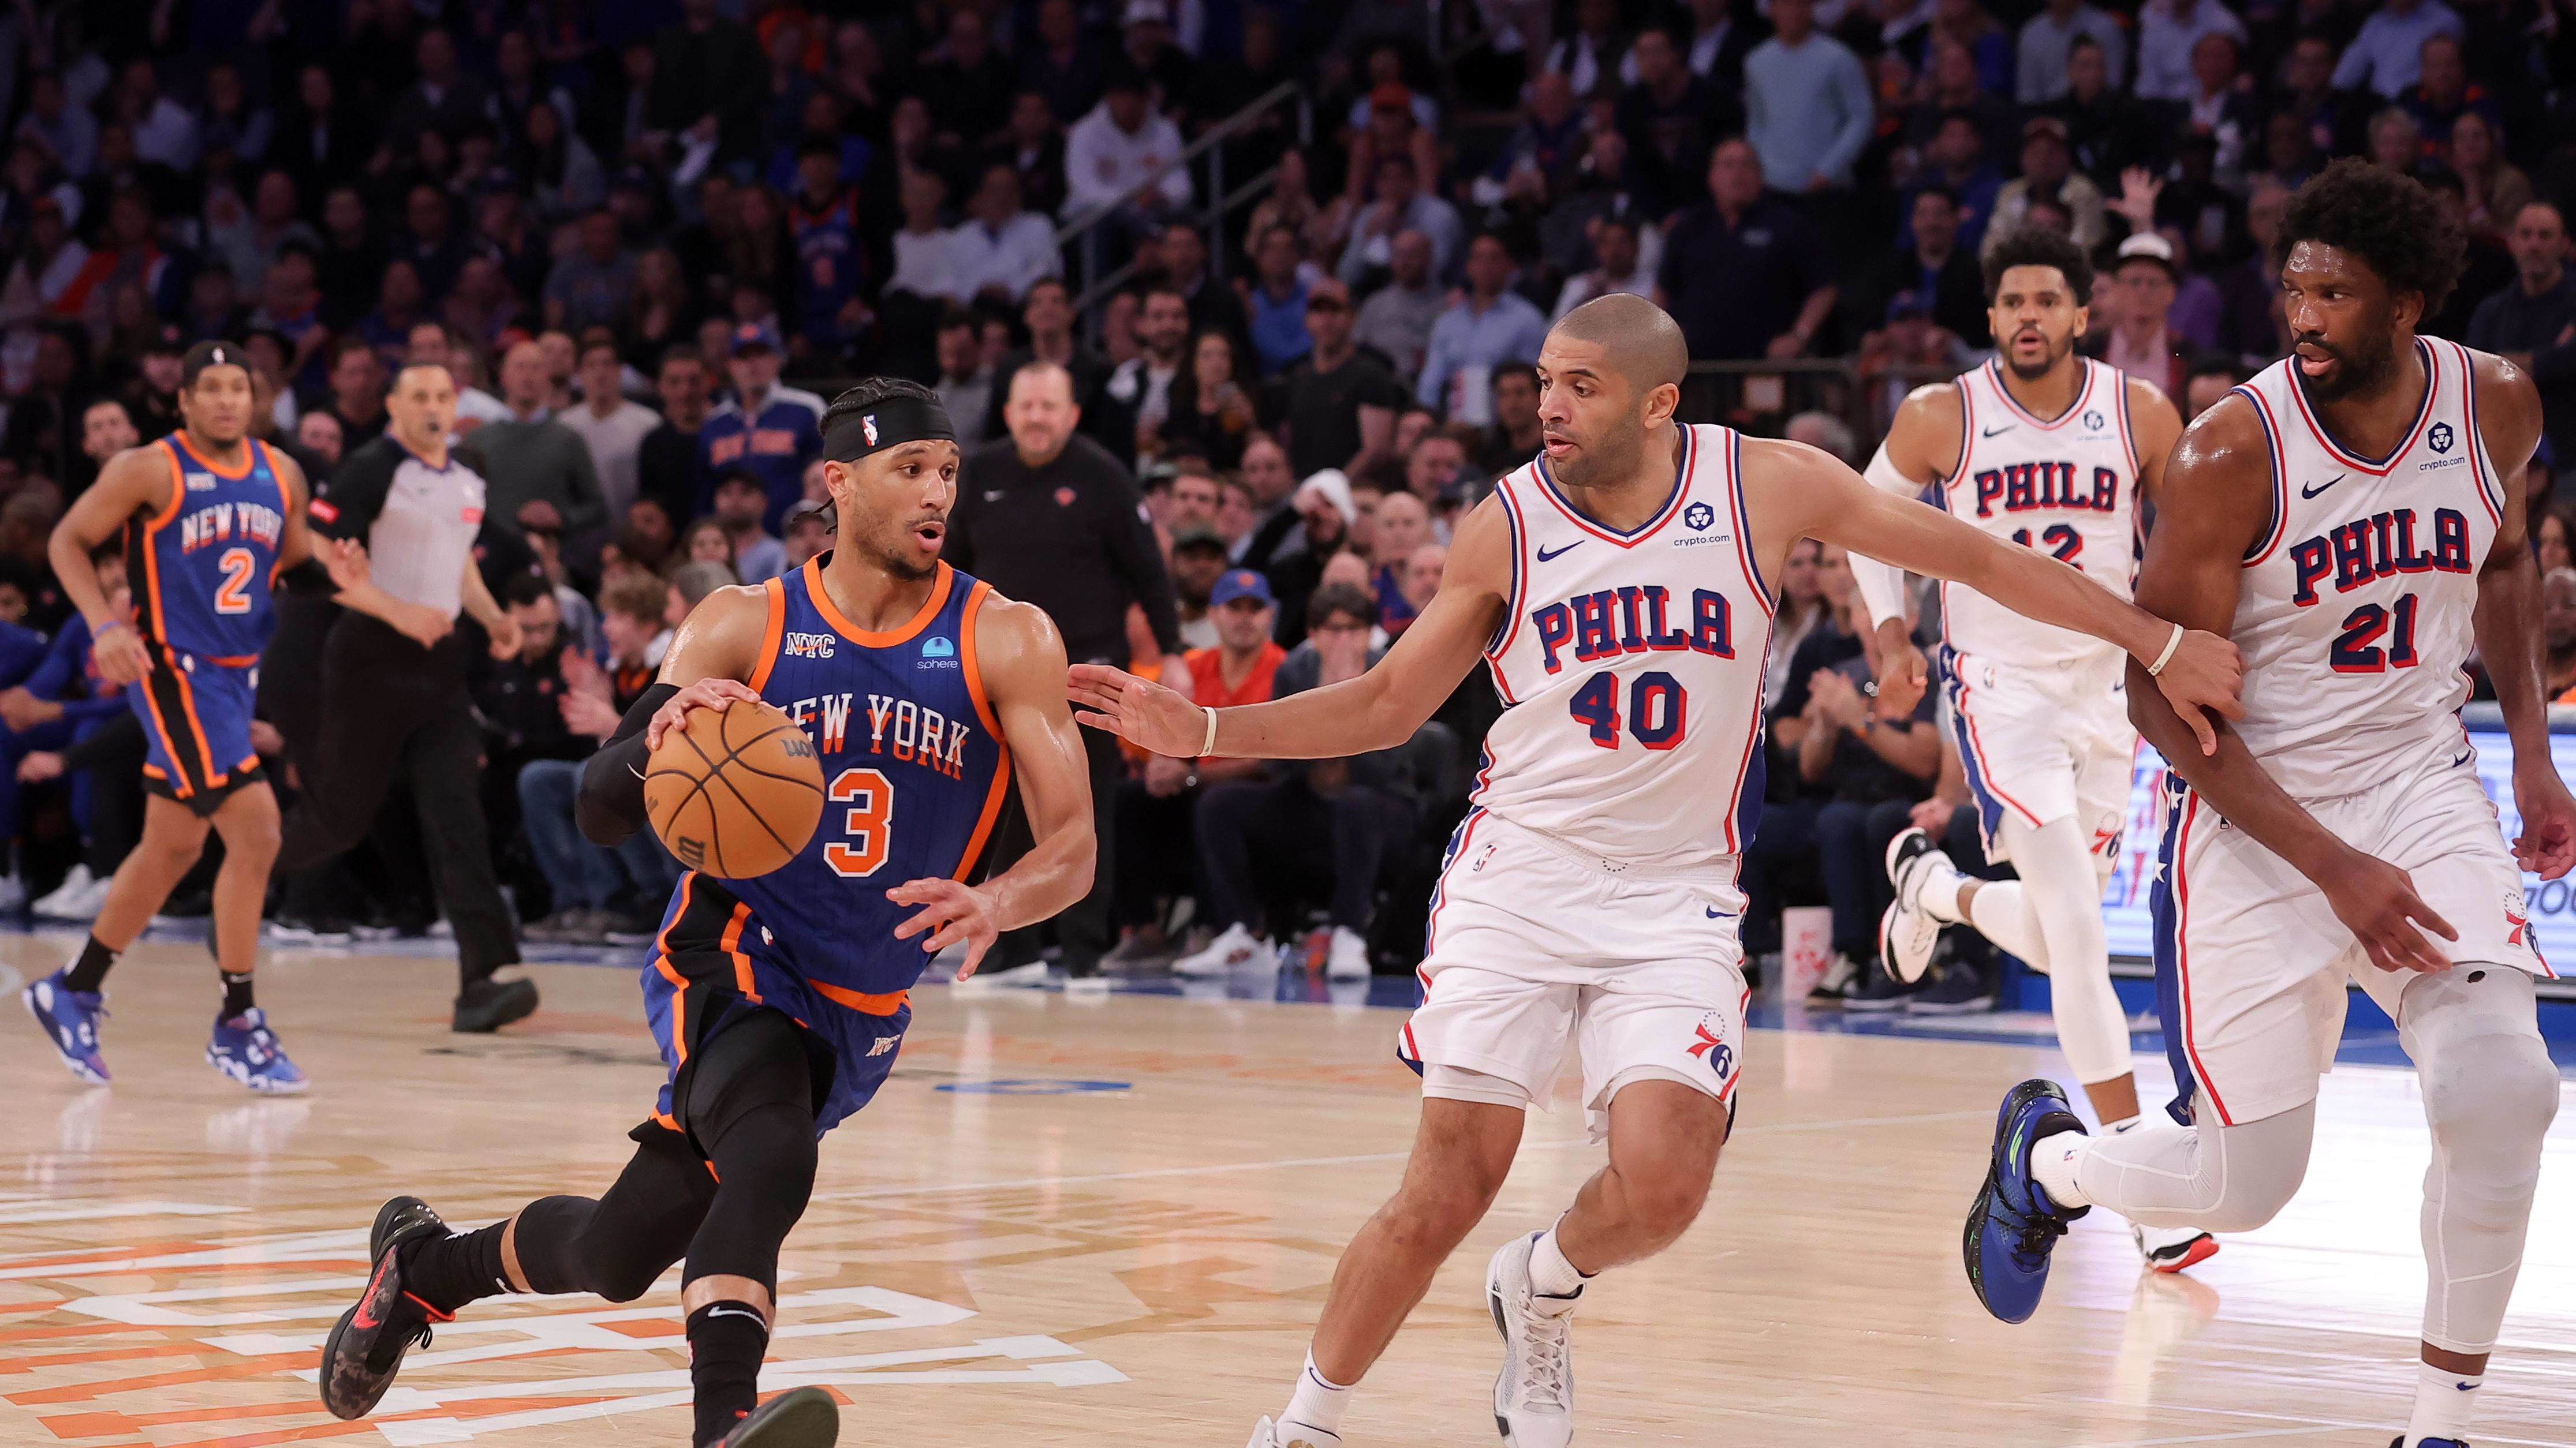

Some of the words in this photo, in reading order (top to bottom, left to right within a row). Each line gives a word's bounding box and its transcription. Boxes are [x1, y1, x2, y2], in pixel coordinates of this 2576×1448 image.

[1974, 461, 2118, 519] PHILA
[2419, 457, 2465, 471] crypto.com
[181, 502, 233, 556] NEW
[1674, 534, 1730, 548] crypto.com
[2290, 507, 2472, 607] PHILA
[214, 547, 255, 615] 2
[785, 632, 835, 658] NYC
[1531, 585, 1735, 675] PHILA
[2329, 593, 2418, 673] 21
[917, 660, 958, 669] sphere
[778, 693, 853, 754] EW
[867, 694, 970, 780] YORK
[1570, 671, 1688, 750] 40
[823, 768, 894, 877] 3
[2090, 828, 2123, 859] 76
[1686, 1022, 1733, 1080] 76
